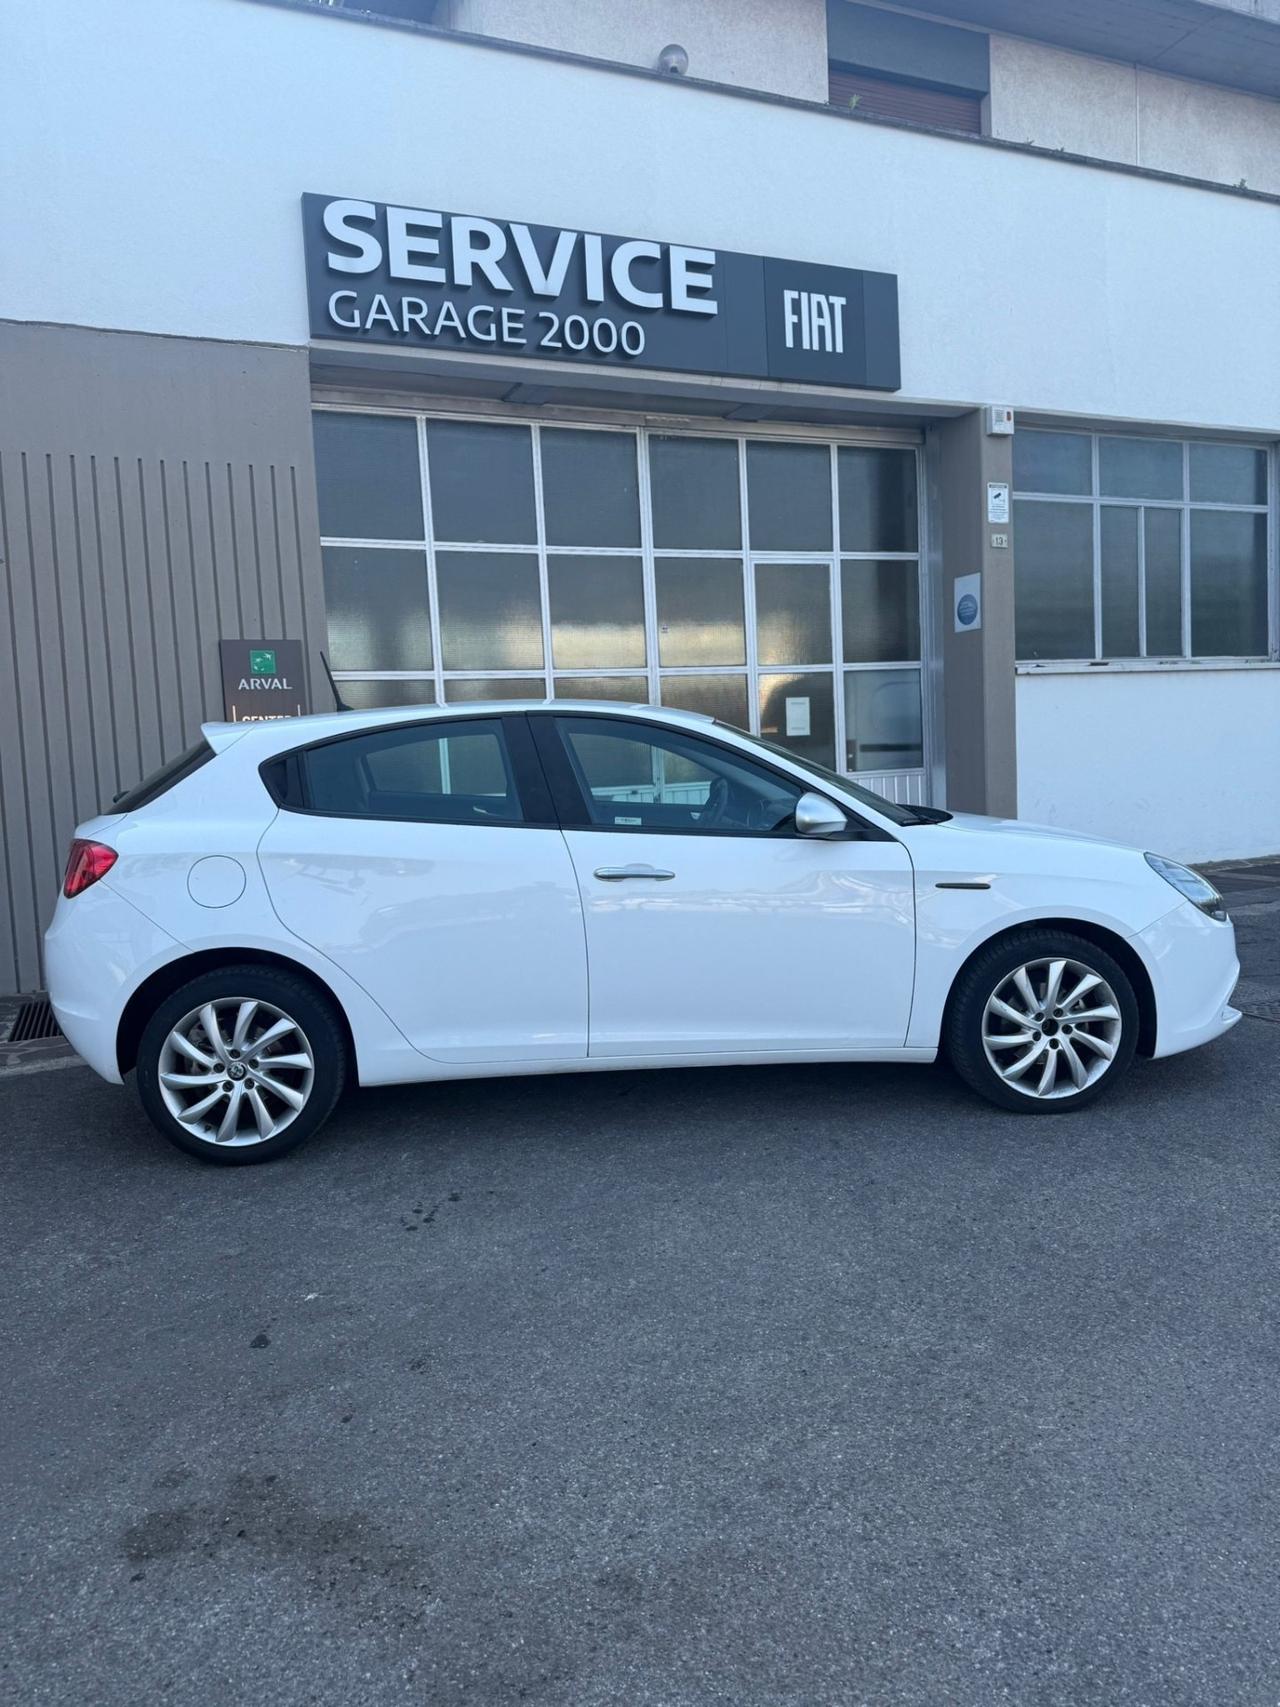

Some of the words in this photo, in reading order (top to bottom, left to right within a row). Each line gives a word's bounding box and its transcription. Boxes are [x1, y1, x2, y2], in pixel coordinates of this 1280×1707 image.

[322, 199, 719, 316] SERVICE
[328, 290, 527, 345] GARAGE
[538, 311, 646, 356] 2000
[783, 290, 847, 354] FIAT
[995, 536, 1004, 546] 13
[238, 678, 293, 690] ARVAL
